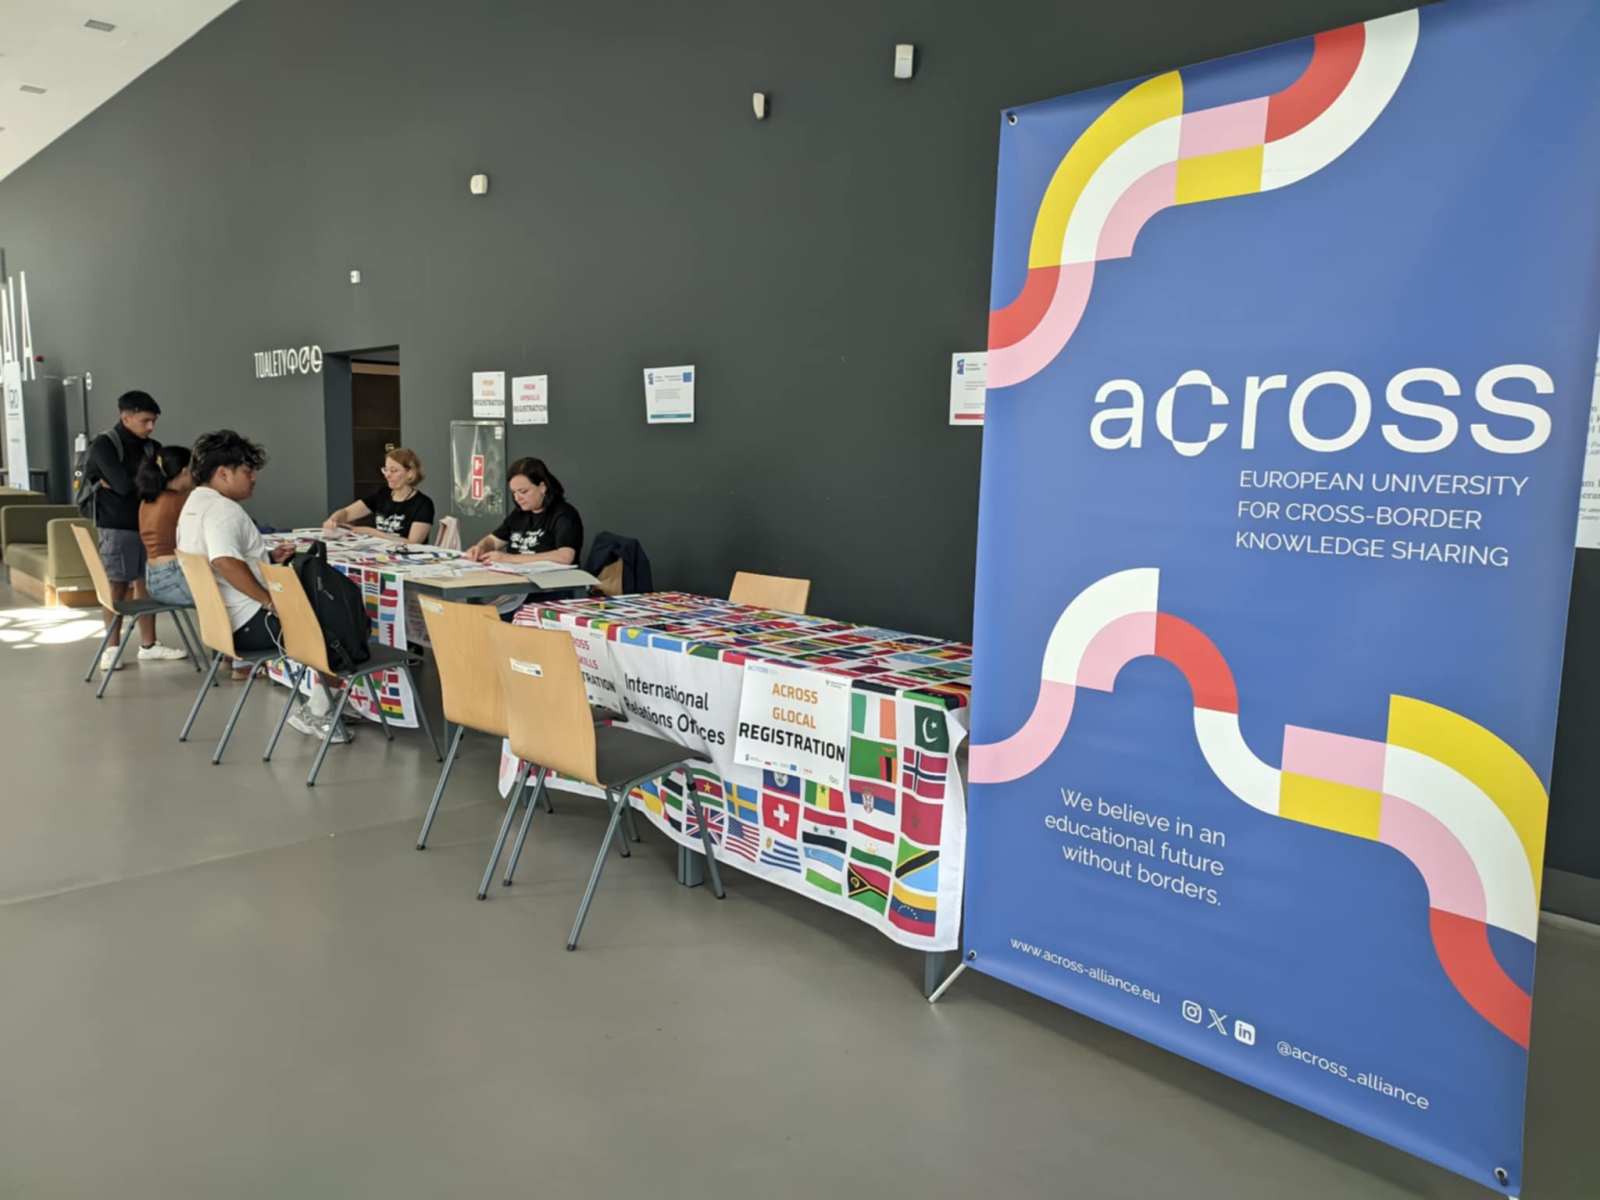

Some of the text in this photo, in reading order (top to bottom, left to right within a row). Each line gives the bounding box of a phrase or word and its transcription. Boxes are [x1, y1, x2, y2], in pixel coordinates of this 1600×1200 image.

[1089, 363, 1555, 457] across
[1239, 470, 1528, 496] EUROPEAN UNIVERSITY
[1237, 501, 1483, 530] FOR CROSS-BORDER
[1235, 531, 1510, 567] KNOWLEDGE SHARING
[624, 672, 709, 711] International
[772, 683, 819, 705] ACROSS
[772, 706, 817, 729] GLOCAL
[739, 722, 846, 763] REGISTRATION
[1060, 787, 1226, 847] We believe in an
[1044, 814, 1225, 876] educational future
[1062, 845, 1222, 906] without borders.
[1009, 937, 1161, 1005] www.across-alliance.eu
[1276, 1040, 1431, 1111] @across_alliance
